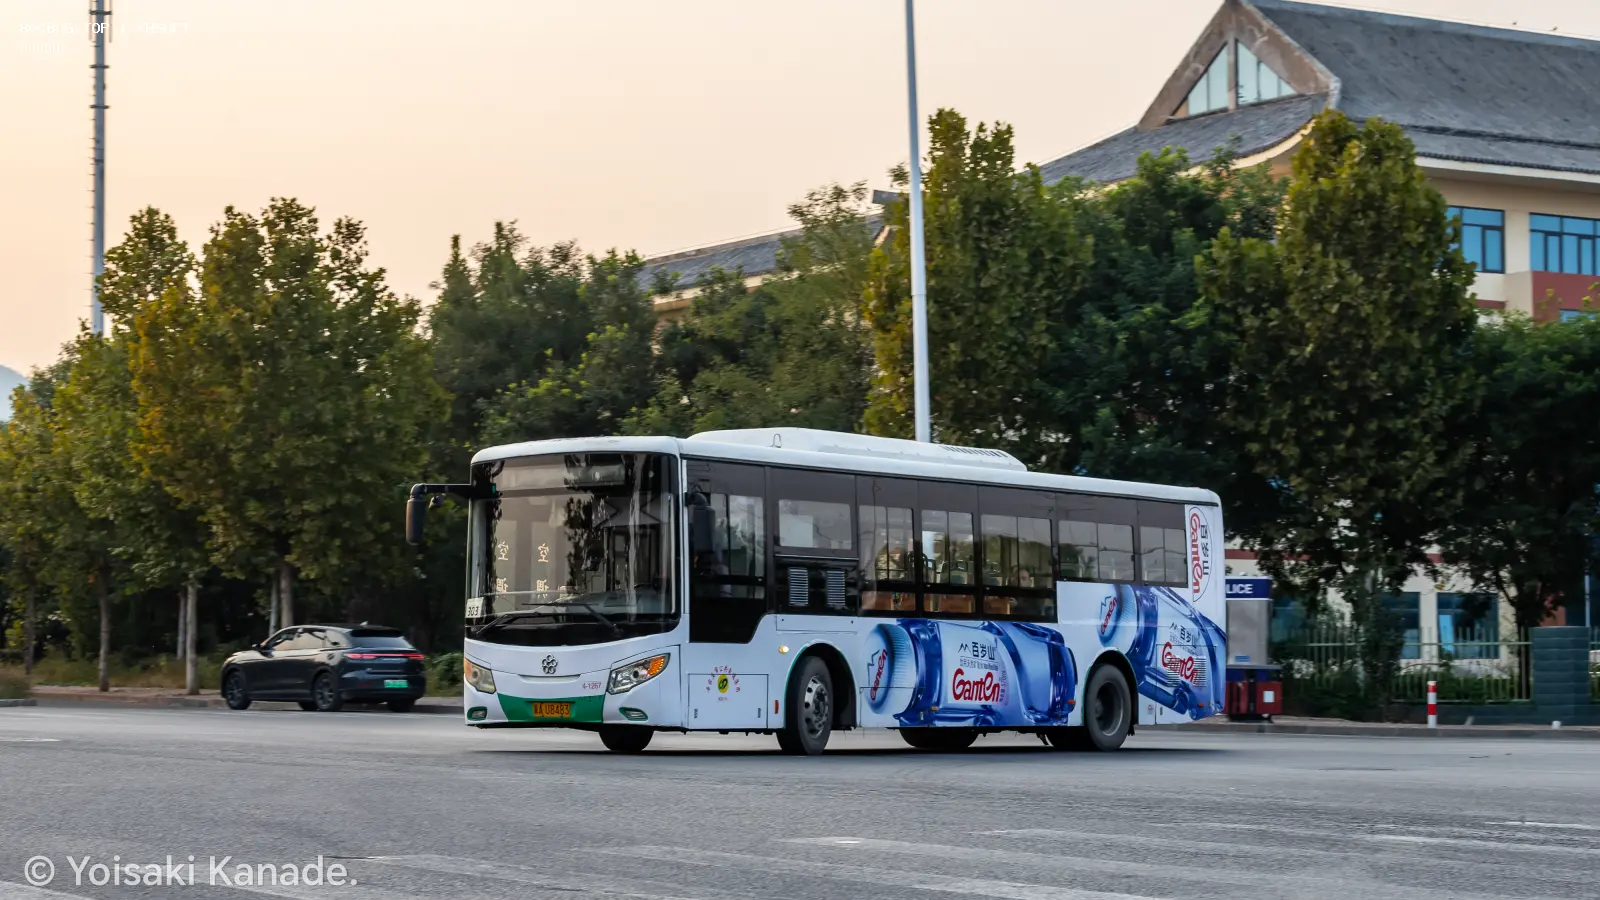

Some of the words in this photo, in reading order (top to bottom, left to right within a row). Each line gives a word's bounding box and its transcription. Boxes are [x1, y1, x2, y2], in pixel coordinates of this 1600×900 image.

[1201, 525, 1210, 575] 百岁山
[467, 606, 480, 617] 303
[971, 641, 996, 660] 百岁山
